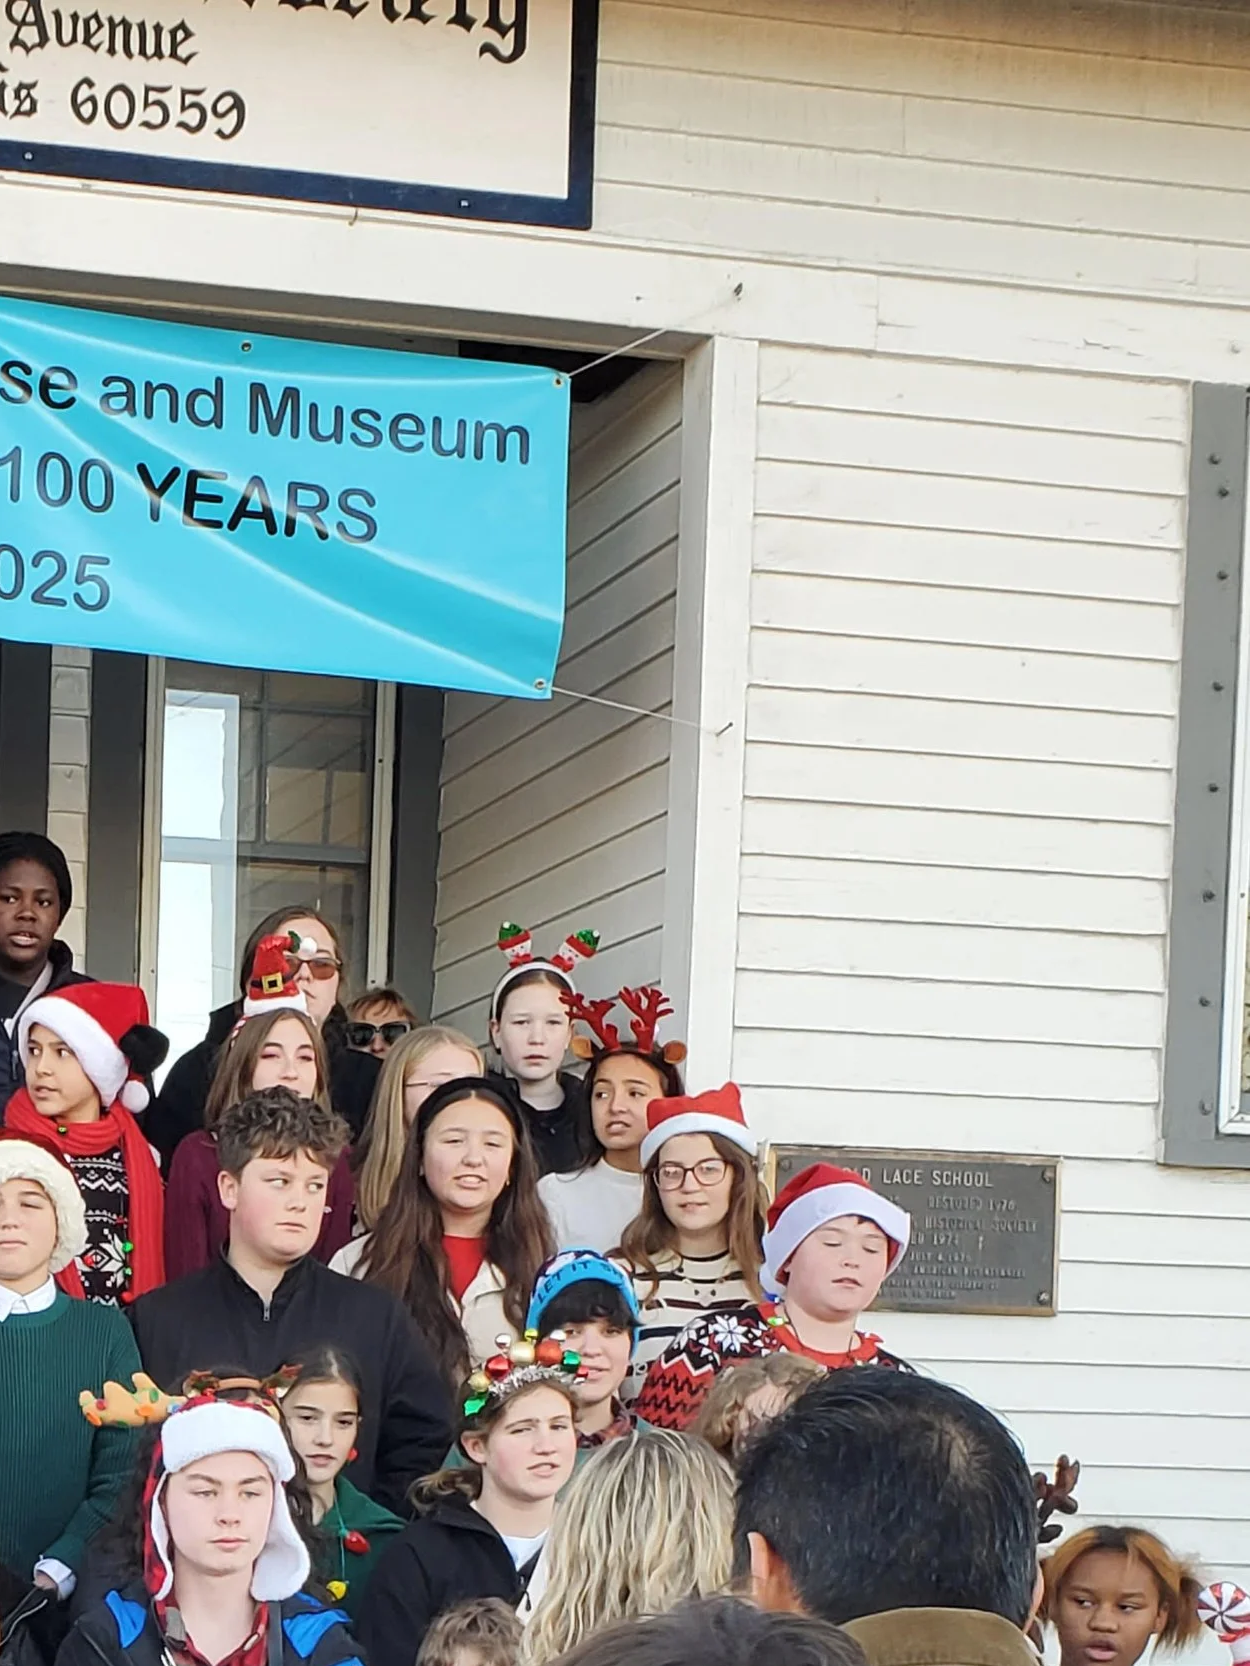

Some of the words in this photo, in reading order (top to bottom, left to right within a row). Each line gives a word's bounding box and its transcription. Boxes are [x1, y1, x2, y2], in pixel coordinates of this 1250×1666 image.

[6, 0, 199, 66] Avenue
[69, 77, 247, 140] 60559
[99, 377, 224, 431] and
[248, 382, 531, 466] Museum
[136, 461, 379, 545] YEARS
[883, 1167, 923, 1185] LACE
[932, 1170, 994, 1188] SCHOOL
[538, 1269, 564, 1304] LET
[571, 1260, 591, 1273] IT
